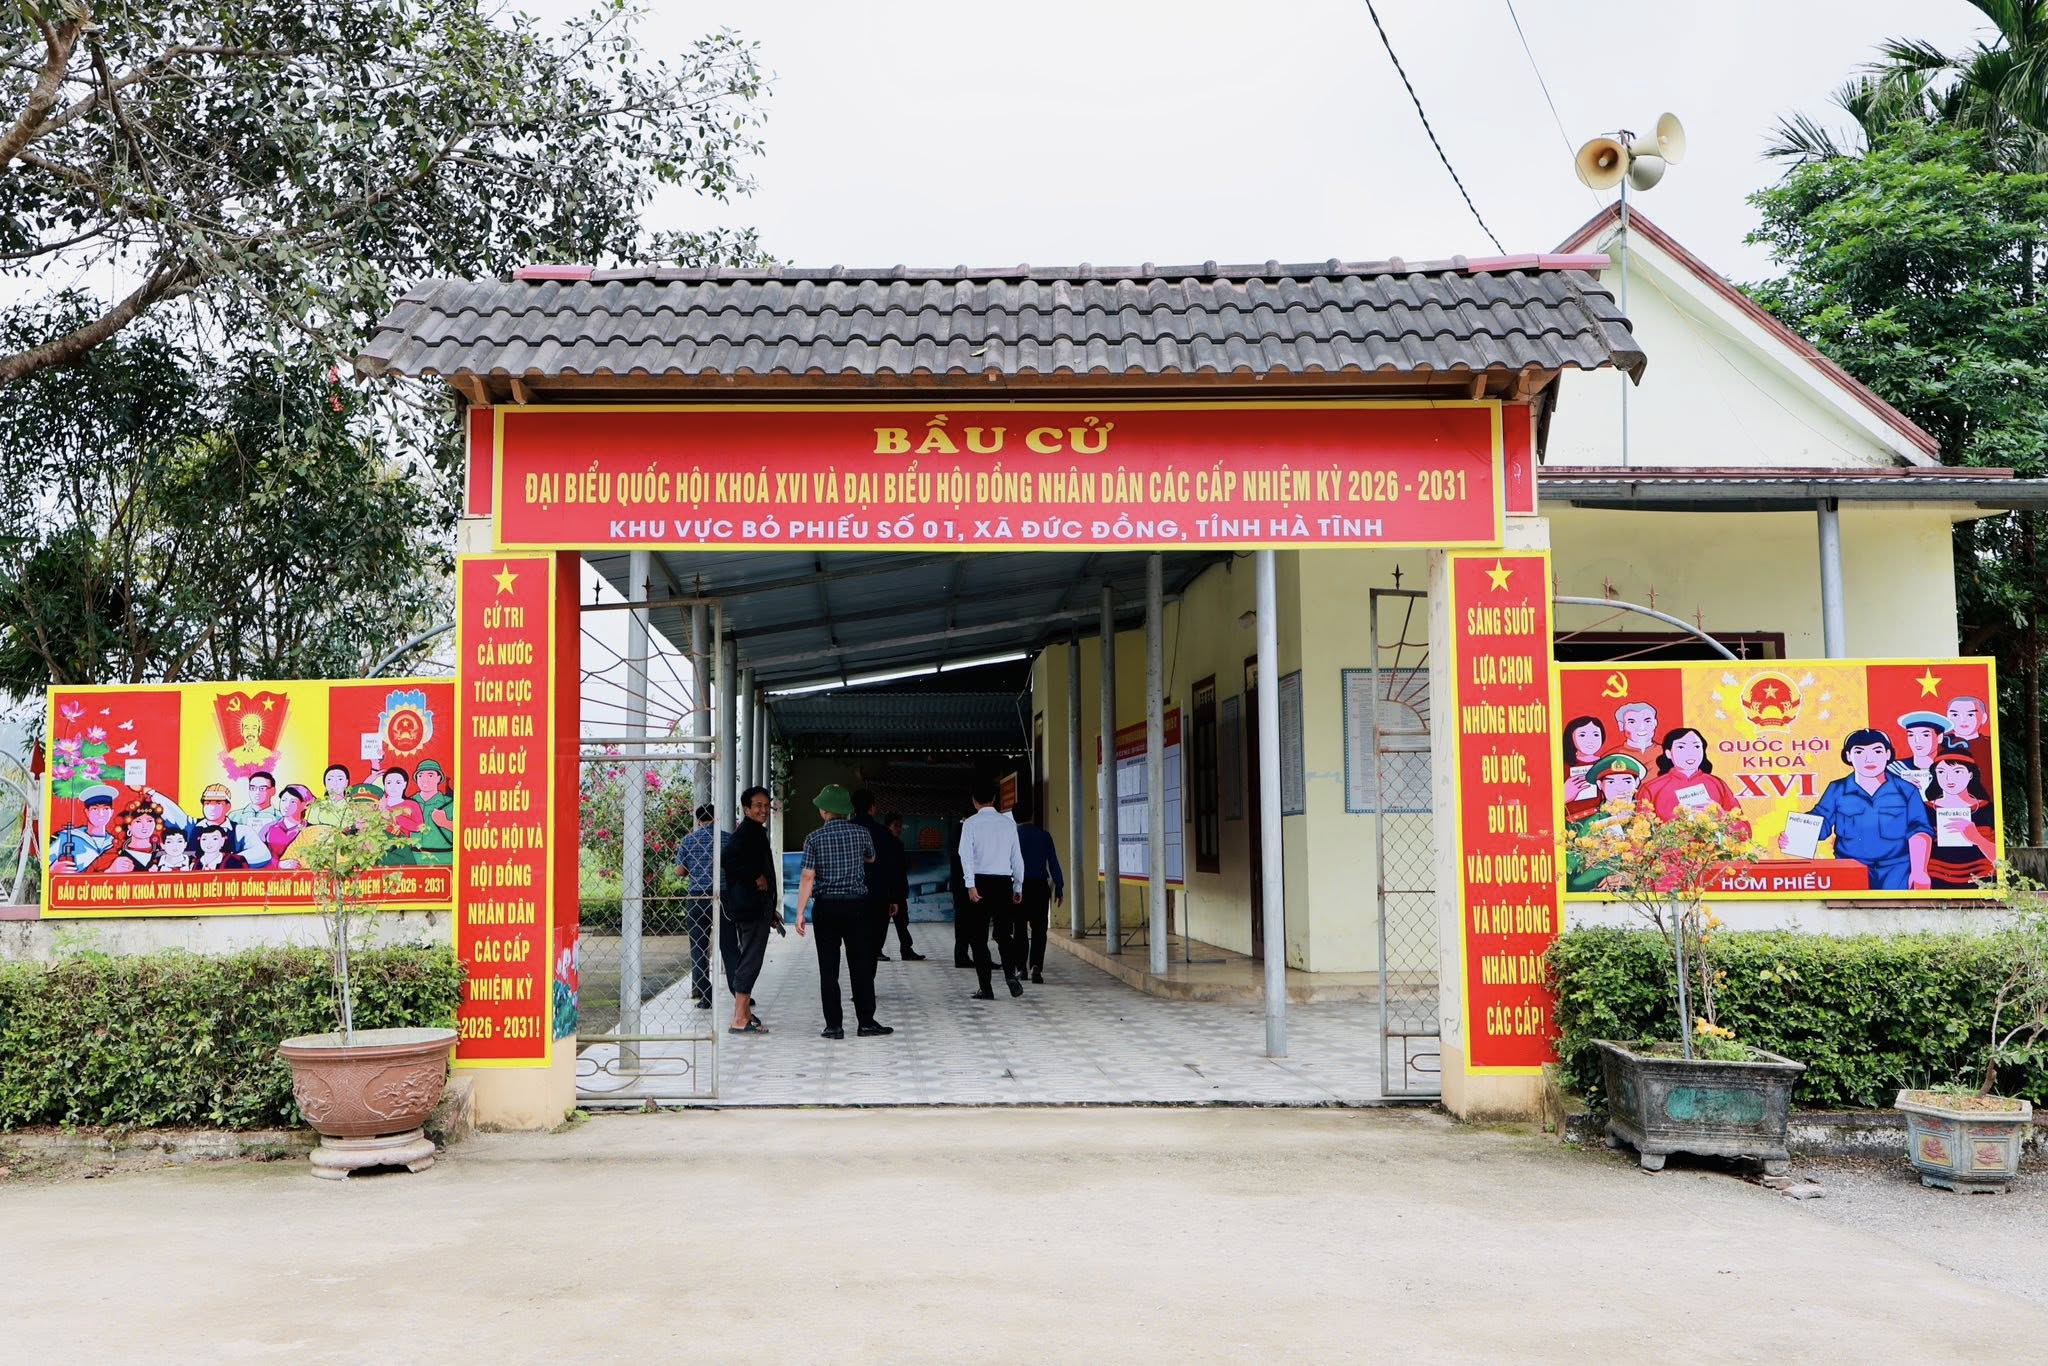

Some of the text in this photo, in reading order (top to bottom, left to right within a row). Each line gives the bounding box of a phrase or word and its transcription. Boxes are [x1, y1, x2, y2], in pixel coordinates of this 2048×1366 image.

[874, 415, 1113, 454] BẦU CỬ
[525, 473, 558, 510] ĐẠI
[565, 460, 610, 503] BIỂU
[617, 462, 670, 506] QUỐC
[676, 466, 709, 510] HỘI
[716, 467, 769, 503] KHOÁ
[775, 473, 807, 503] XVI
[814, 467, 838, 503] VÀ
[844, 473, 877, 510] ĐẠI
[885, 460, 930, 503] BIỂU
[937, 466, 970, 510] HỘI
[976, 462, 1032, 503] ĐỒNG
[1039, 466, 1095, 503] NHÂN
[1102, 466, 1143, 503] DÂN
[1150, 466, 1189, 503] CÁC
[1197, 461, 1236, 502] CẤP
[1243, 464, 1310, 508] NHIỆM
[1317, 464, 1342, 501] KỲ
[1349, 471, 1398, 501] 2026
[1418, 470, 1465, 500] 2031
[611, 512, 1382, 544] KHU VỰC BỎ PHIẾU SỐ 01, XÃ ĐỨC ĐỒNG, TỈNH HÀ TĨNH
[484, 600, 523, 628] CỬ TRI
[1468, 598, 1535, 635] SÁNG SUỐT
[478, 637, 532, 665] CẢ NƯỚC
[1473, 654, 1532, 690] LỰA CHỌN
[474, 677, 531, 706] TÍCH CỰC
[472, 716, 533, 737] THAM GIA
[1463, 699, 1546, 733] NHỮNG NGƯỜI
[480, 746, 526, 774] BẦU CỬ
[1719, 737, 1829, 753] QUỐC HỘI
[1743, 753, 1805, 767] KHOÁ
[1482, 746, 1530, 785] ĐỦ ĐỨC,
[475, 781, 529, 816] ĐẠI BIỂU
[1735, 774, 1816, 797] XVI
[1489, 796, 1527, 833] ĐỦ TÀI
[464, 820, 543, 853] QUỐC HỘI VÀ
[471, 858, 531, 891] HỘI ĐỒNG
[1468, 845, 1552, 889] VÀO QUỐC HỘI
[1722, 872, 1833, 892] HÒM PHIẾU
[58, 881, 75, 900] BẦU
[77, 881, 89, 900] CỬ
[91, 881, 113, 901] QUỐC
[116, 882, 130, 902] HỘI
[132, 881, 155, 899] KHOÁ
[157, 884, 171, 898] XVI
[174, 882, 184, 898] VÀ
[187, 883, 201, 901] ĐẠI
[203, 877, 222, 897] BIỂU
[225, 879, 239, 899] HỘI
[242, 877, 264, 896] ĐỒNG
[294, 879, 311, 896] DÂN
[425, 878, 444, 892] 2031
[469, 898, 534, 924] NHÂN DÂN
[1473, 896, 1550, 940] VÀ HỘI ĐỒNG
[475, 933, 530, 962] CÁC CẤP
[1482, 950, 1545, 984] NHÂN DÂN
[470, 974, 532, 1004] NHIỆM KỲ
[459, 1017, 492, 1040] 2026
[504, 1016, 539, 1038] 2031!
[1487, 996, 1544, 1035] CÁC CẤP!
